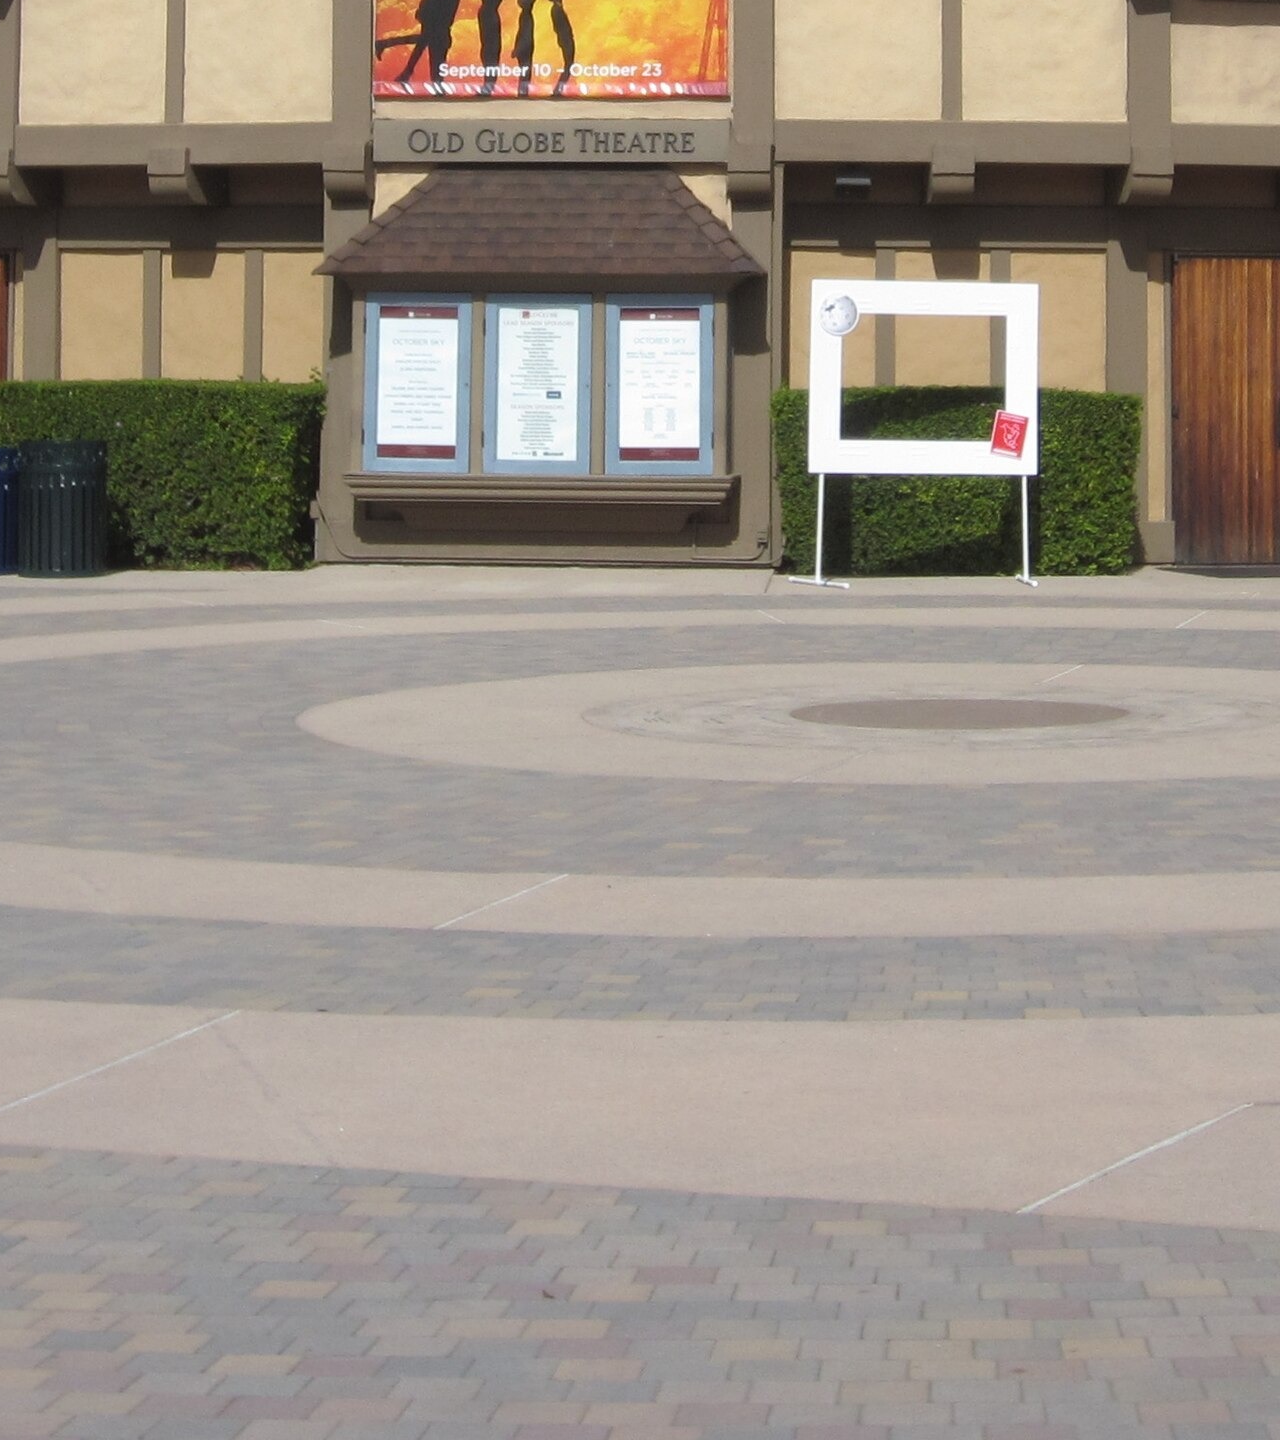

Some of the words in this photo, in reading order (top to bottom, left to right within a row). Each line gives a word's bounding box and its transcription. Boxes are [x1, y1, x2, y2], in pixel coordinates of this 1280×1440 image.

[438, 63, 528, 78] September
[534, 63, 551, 76] 10
[570, 63, 636, 77] October
[642, 63, 661, 76] 23
[408, 128, 464, 153] OLD
[475, 128, 565, 153] GLOBE
[574, 128, 695, 153] THEATRE
